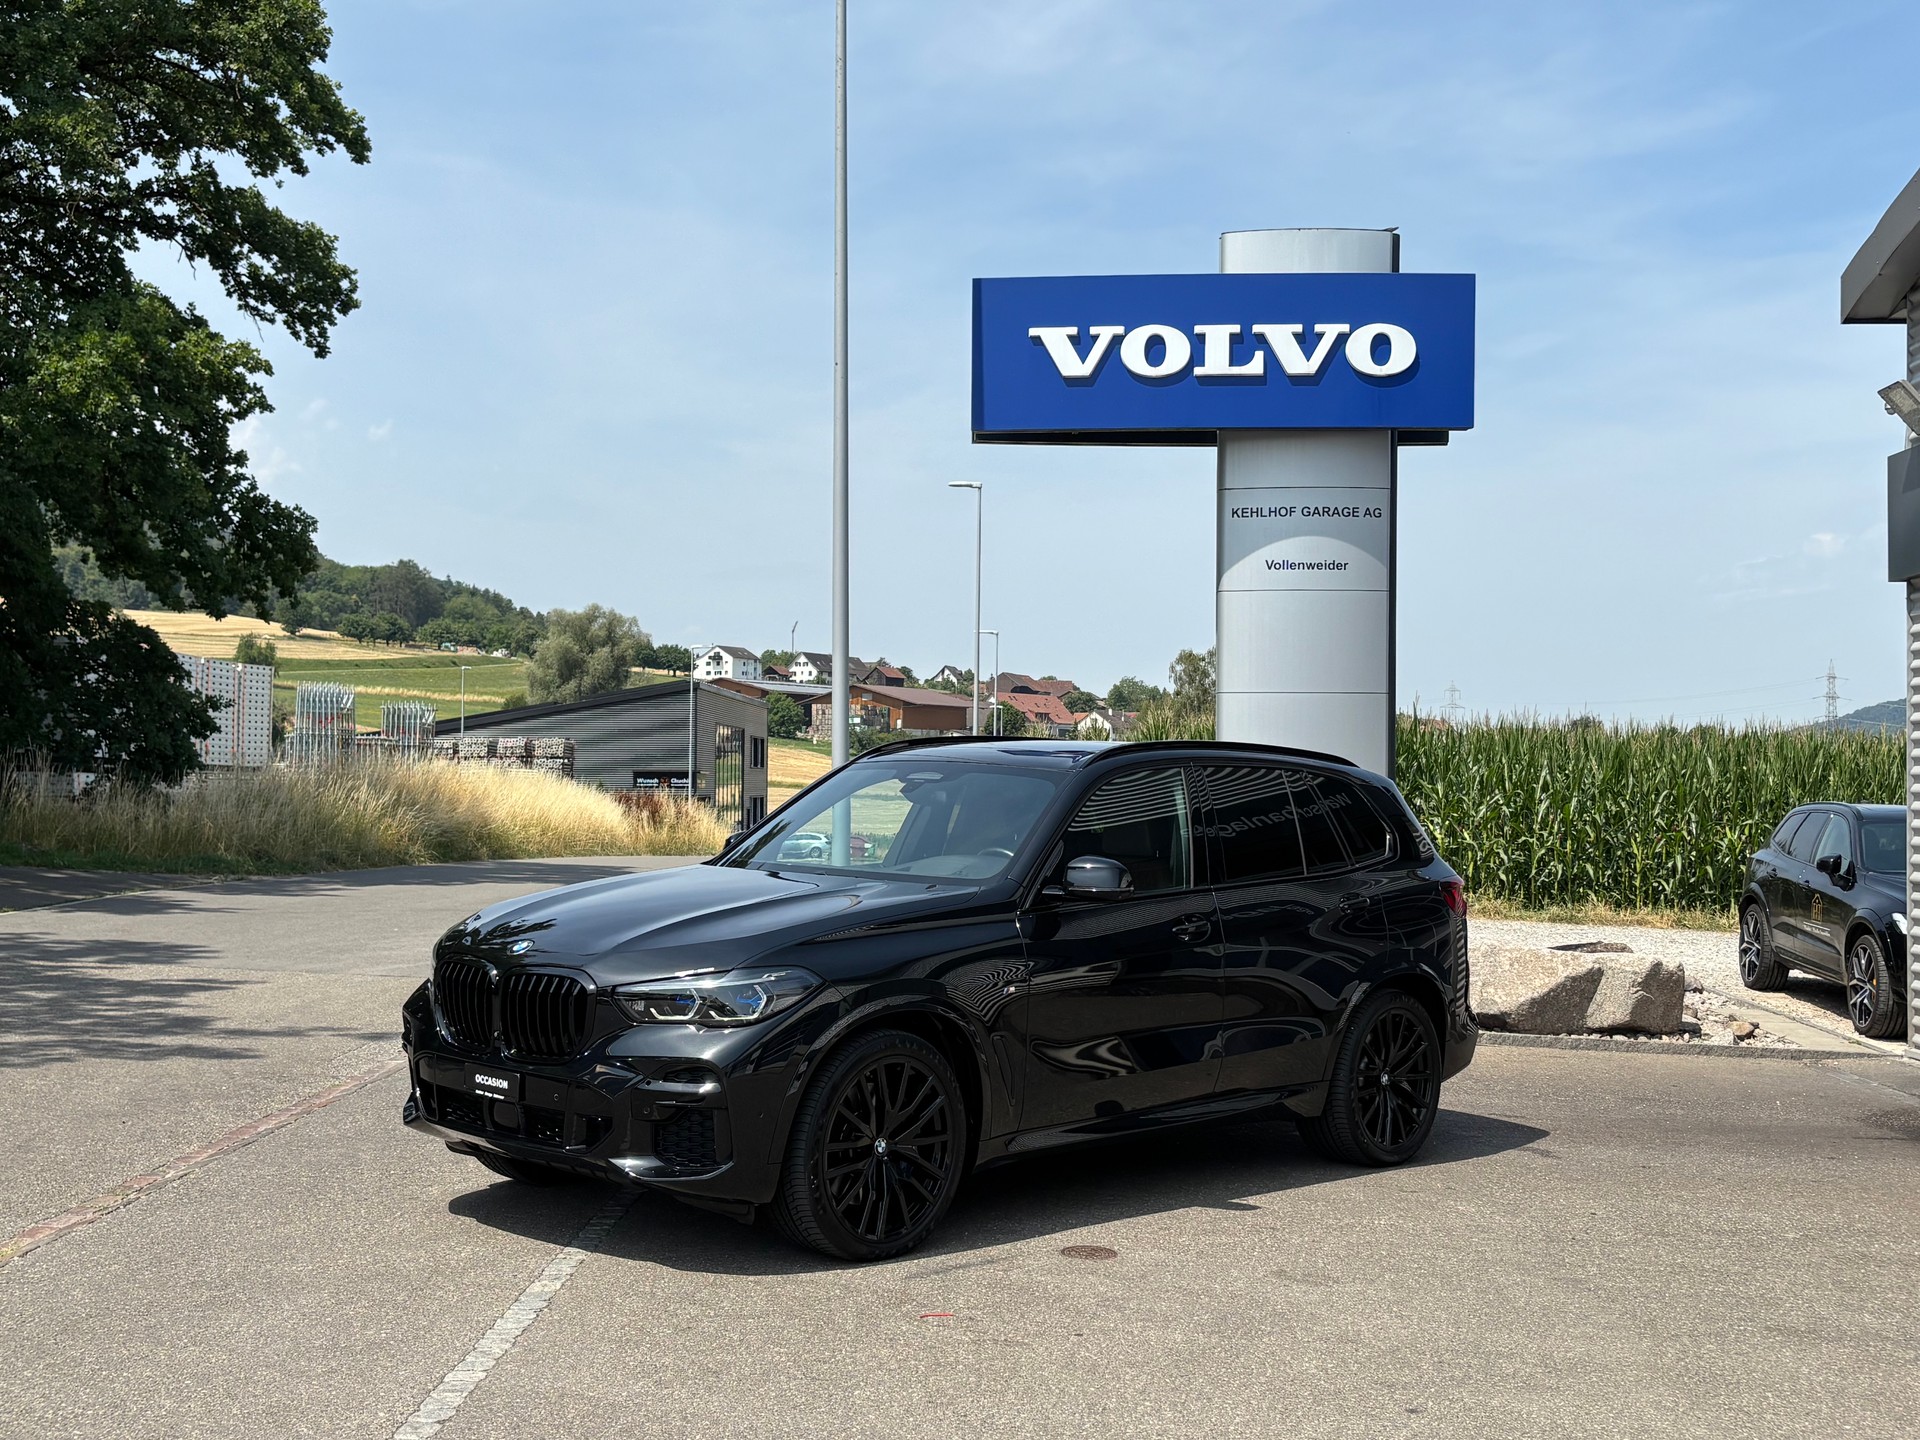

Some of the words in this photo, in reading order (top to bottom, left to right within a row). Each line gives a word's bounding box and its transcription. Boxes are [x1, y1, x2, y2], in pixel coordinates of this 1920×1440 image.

[1028, 322, 1417, 379] VOLVO
[1231, 506, 1297, 519] KEHLHOF
[1301, 506, 1360, 518] GARAGE
[1363, 507, 1383, 519] AG
[1265, 559, 1349, 571] Vollenweider
[475, 1073, 509, 1090] OCCASION
